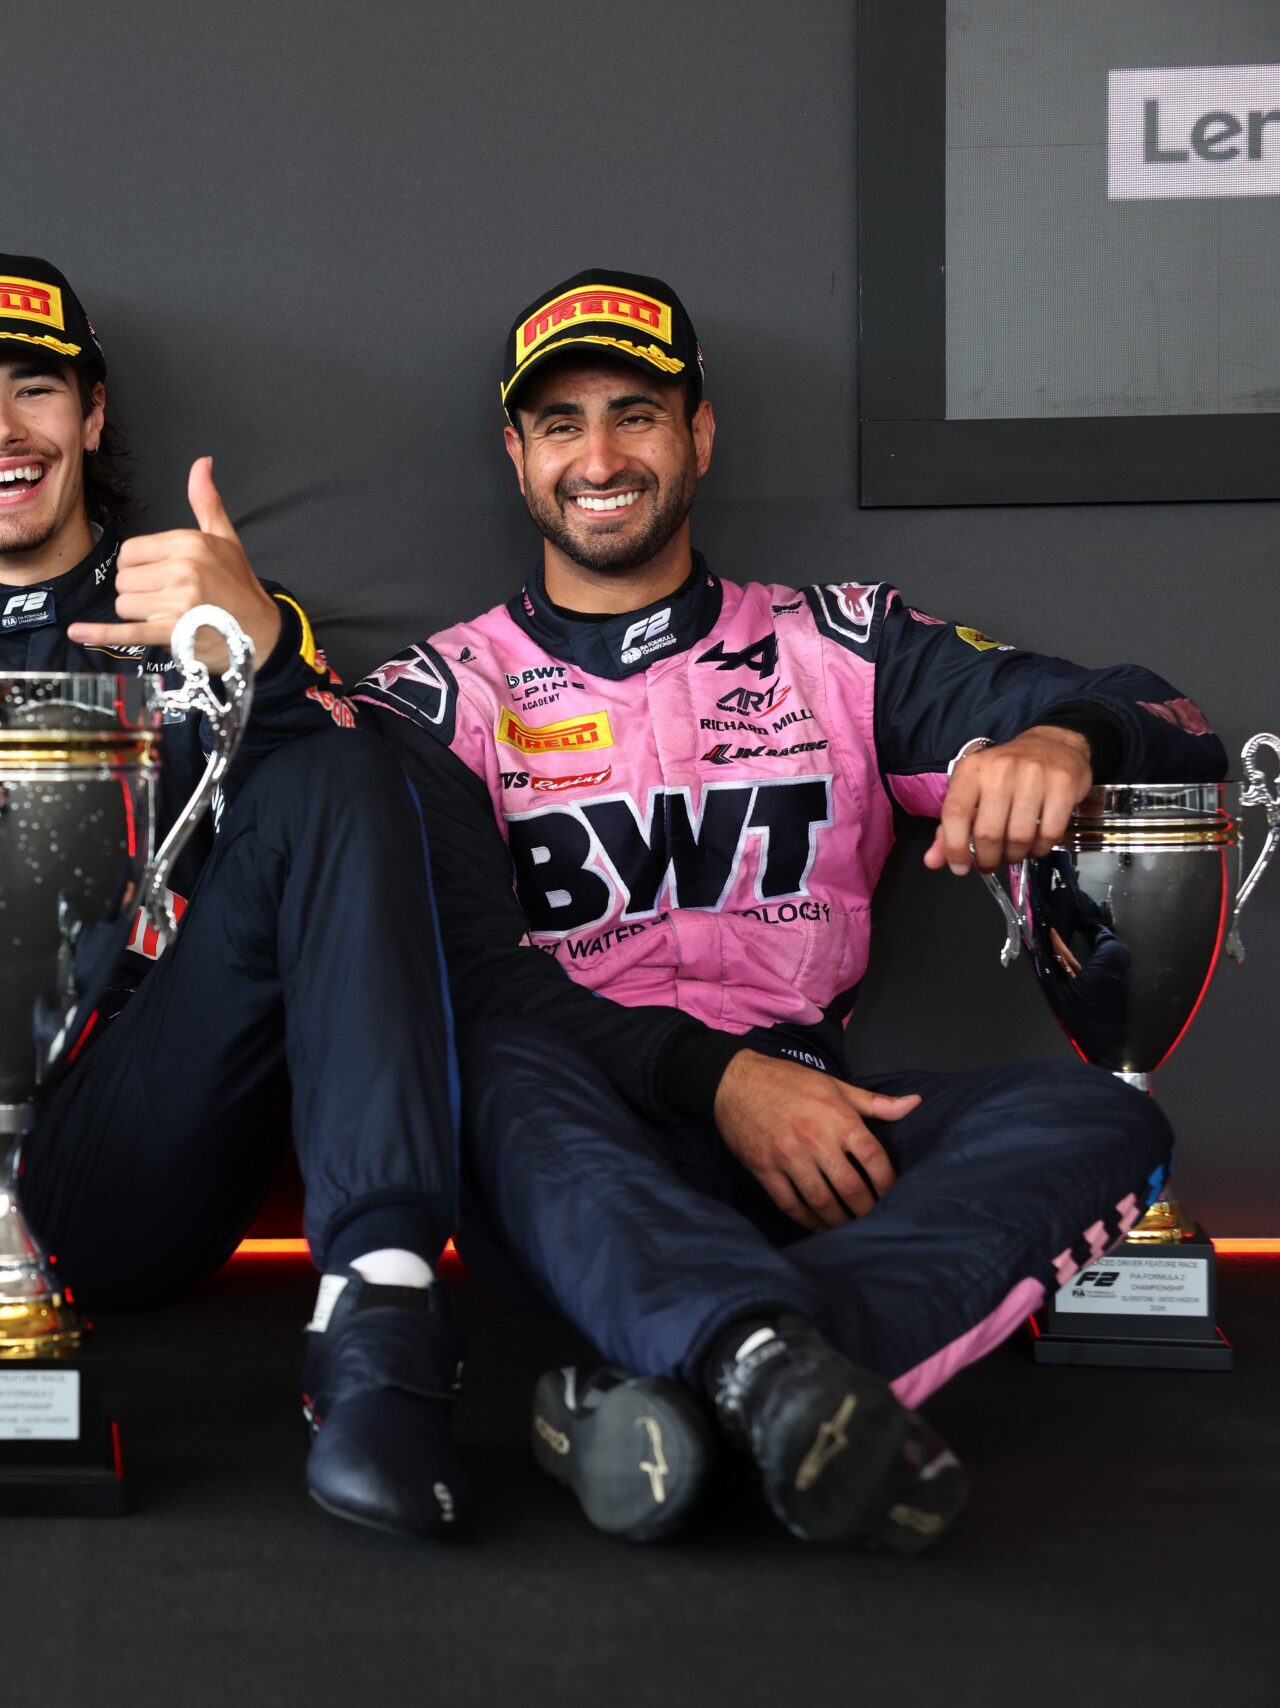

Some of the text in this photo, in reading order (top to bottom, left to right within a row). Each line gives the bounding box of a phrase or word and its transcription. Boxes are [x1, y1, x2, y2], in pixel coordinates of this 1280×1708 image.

[524, 291, 661, 348] PIRELLI
[3, 591, 48, 615] F2
[621, 607, 672, 651] F2
[521, 666, 567, 685] BWT
[522, 693, 561, 711] ACADEMY
[718, 677, 780, 713] ART
[507, 718, 599, 749] PIRELLI
[699, 718, 770, 736] RICHARD
[730, 740, 829, 759] JK RACING
[534, 771, 608, 790] Racing
[506, 774, 833, 937] BWT
[1178, 1261, 1198, 1270] RACE
[1074, 1271, 1120, 1287] F2
